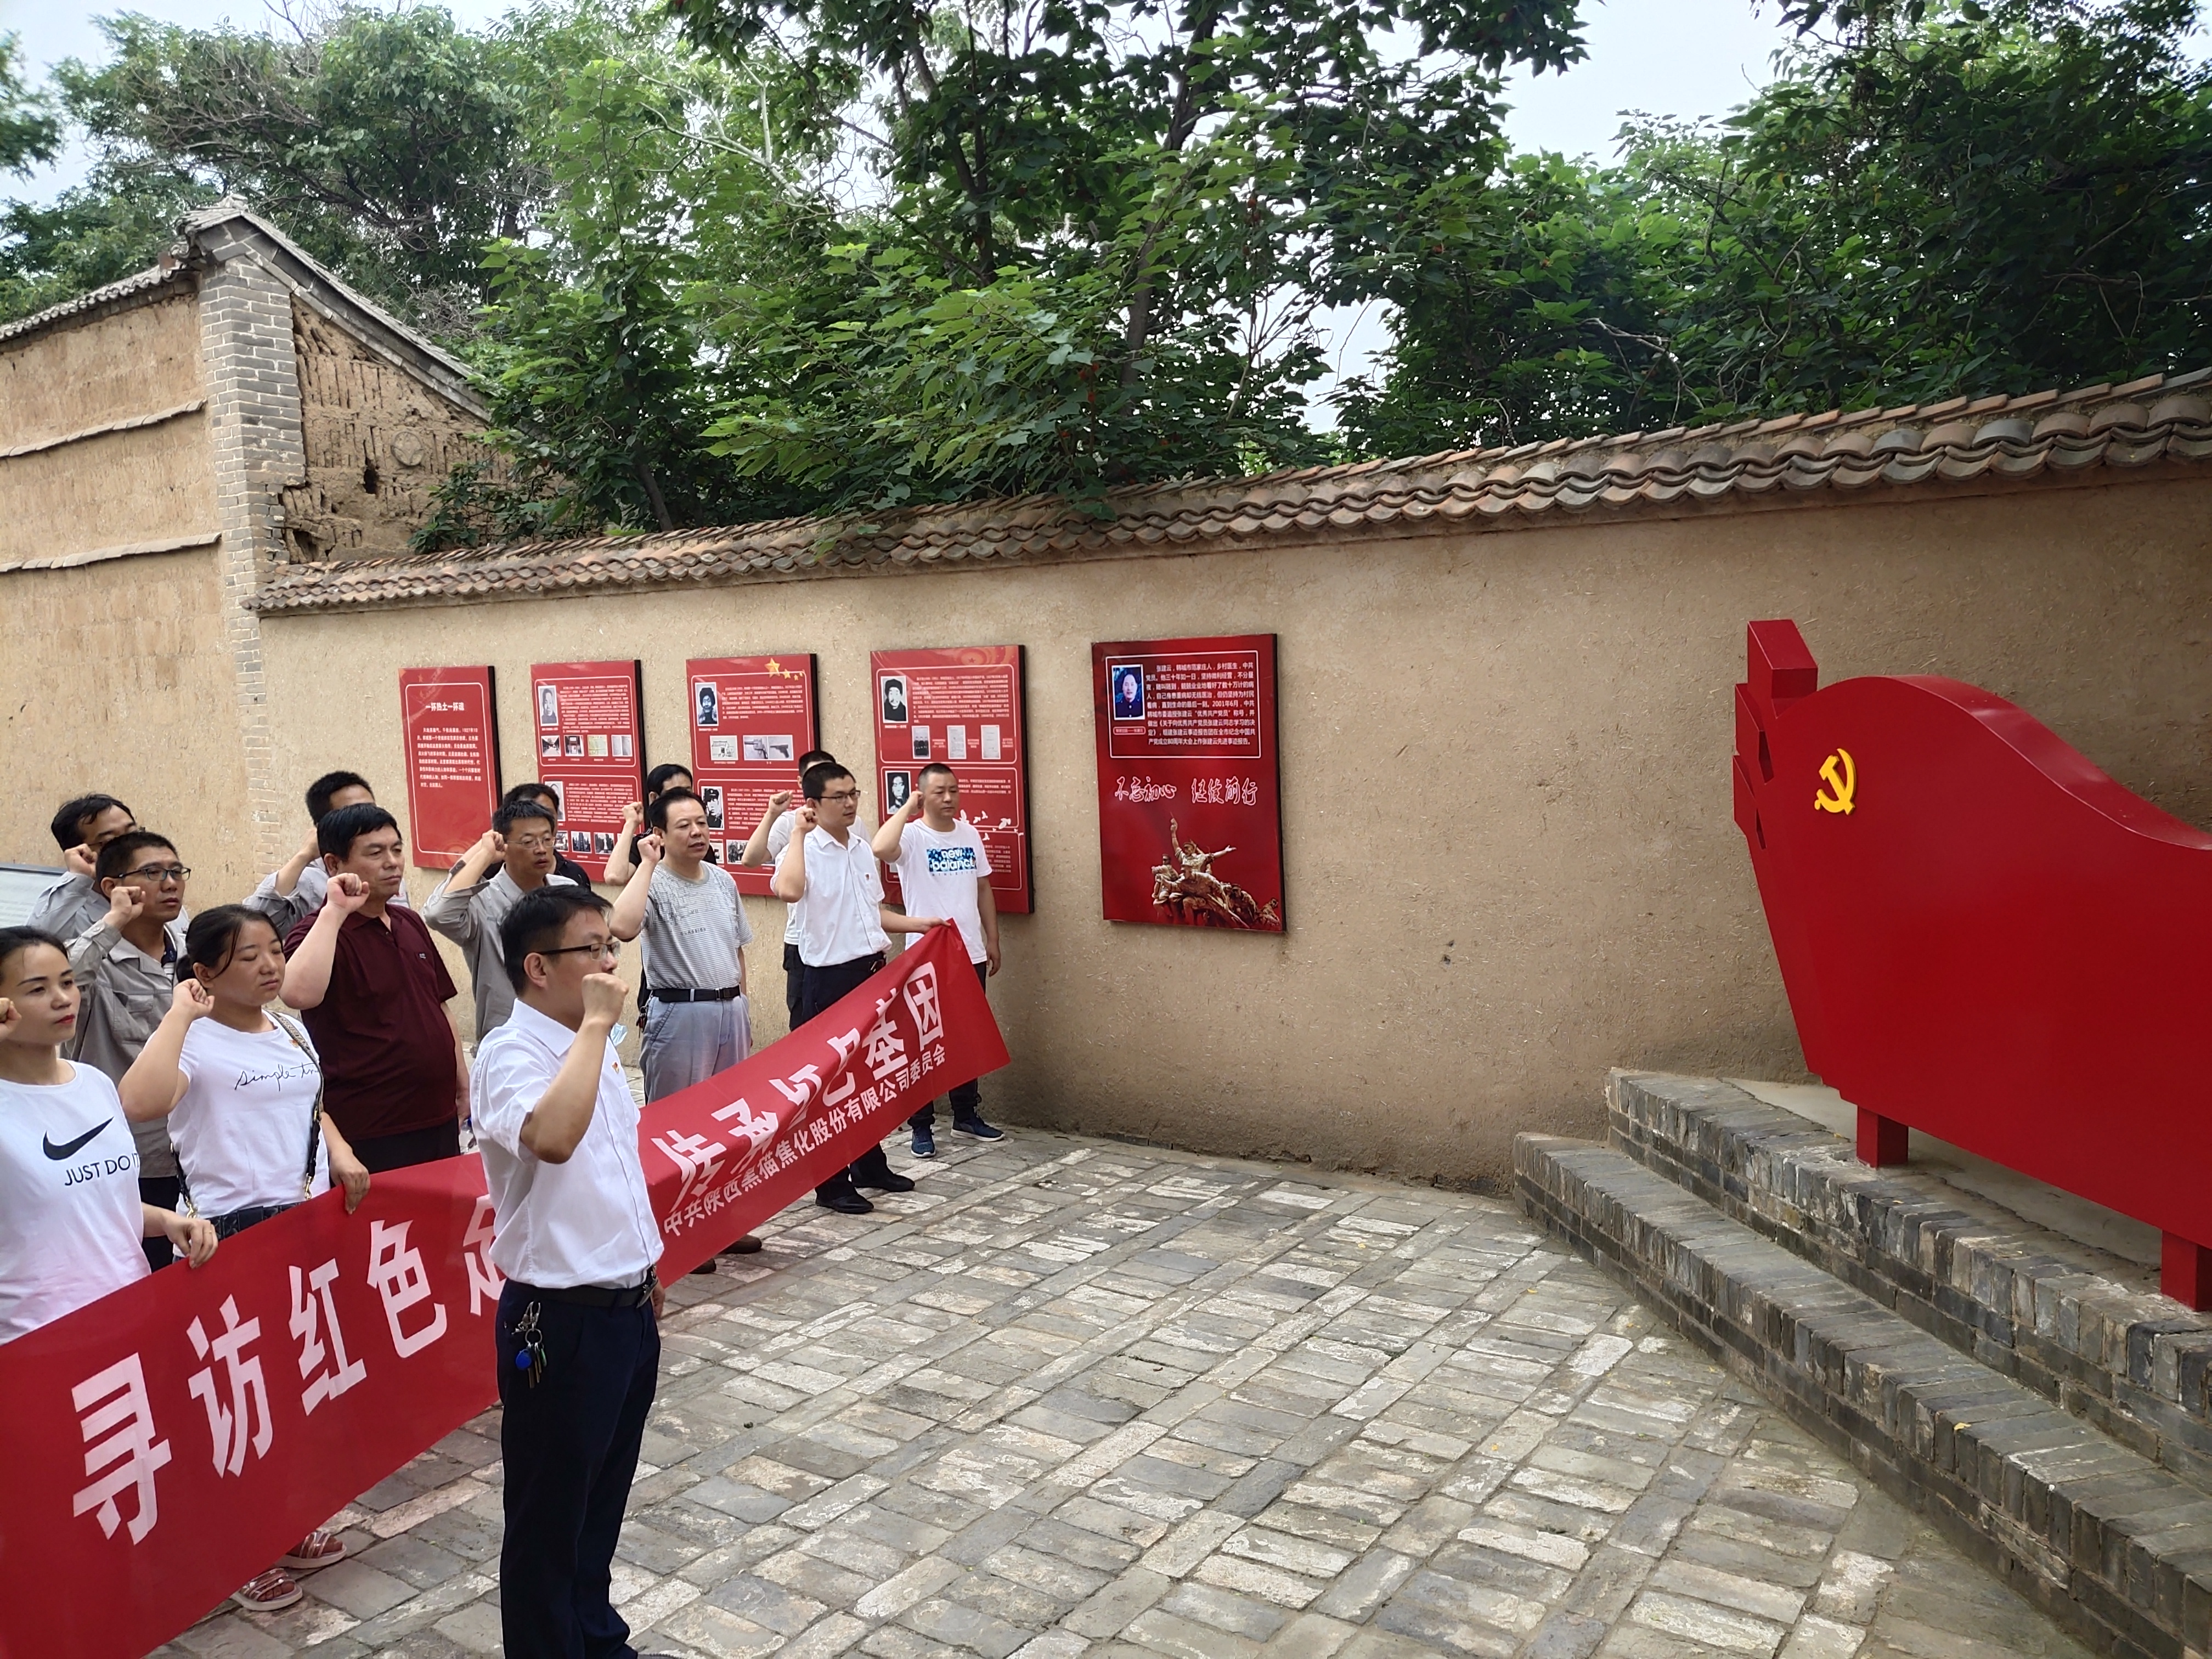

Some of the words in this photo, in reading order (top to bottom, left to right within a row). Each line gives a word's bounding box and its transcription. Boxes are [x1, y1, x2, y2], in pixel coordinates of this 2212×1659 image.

[941, 849, 963, 859] new
[234, 1063, 296, 1091] simple
[663, 1043, 946, 1237] 中共陕西黑猫焦化股份有限公司委员会
[64, 1161, 100, 1186] JUST
[104, 1155, 131, 1175] DO
